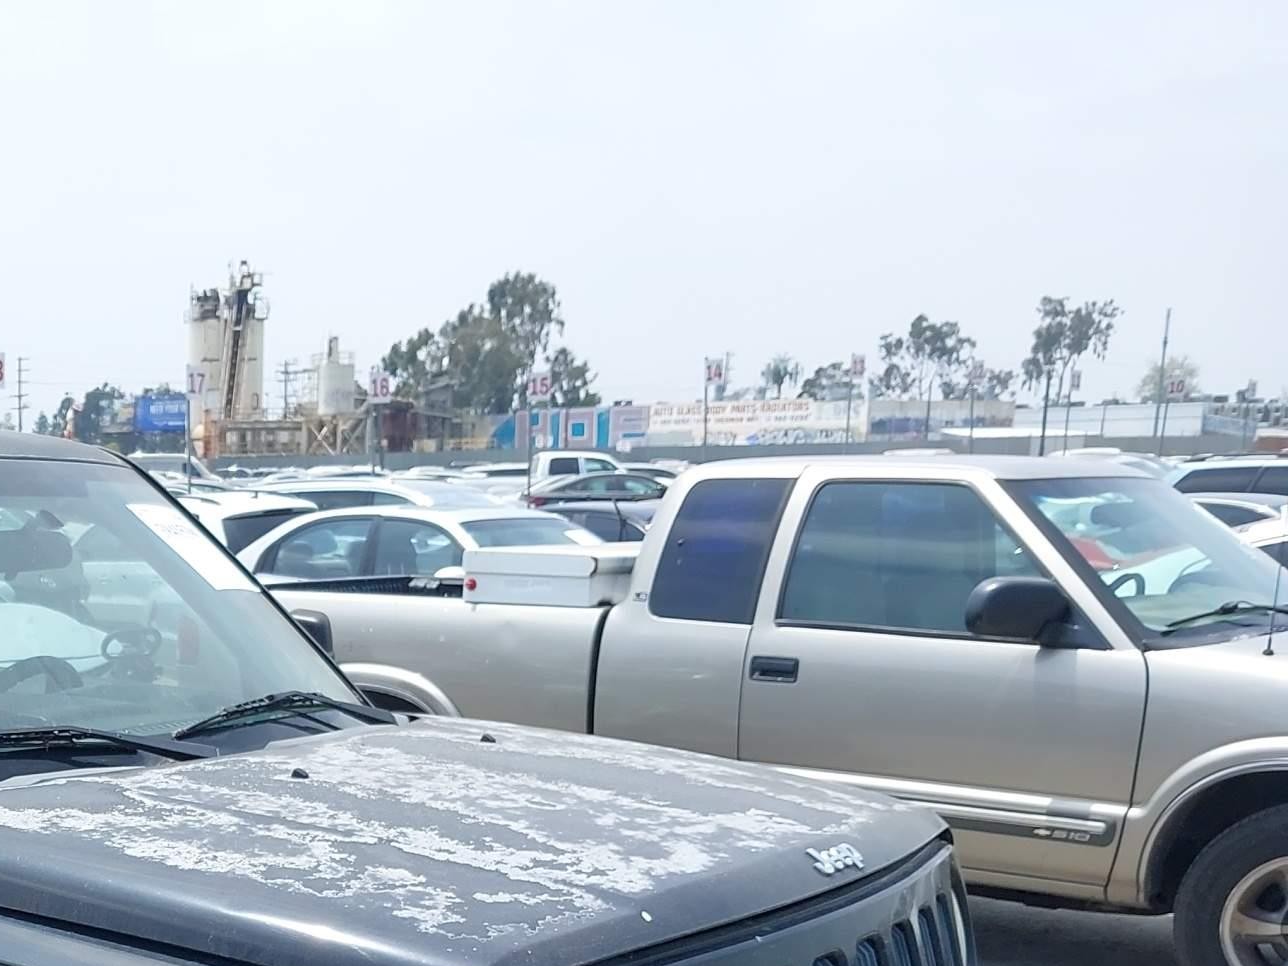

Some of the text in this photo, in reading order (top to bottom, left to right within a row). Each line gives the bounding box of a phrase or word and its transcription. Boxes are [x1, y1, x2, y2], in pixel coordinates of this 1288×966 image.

[706, 363, 722, 381] 14
[189, 372, 205, 394] 17
[530, 377, 549, 396] 15
[805, 843, 865, 874] Jeep
